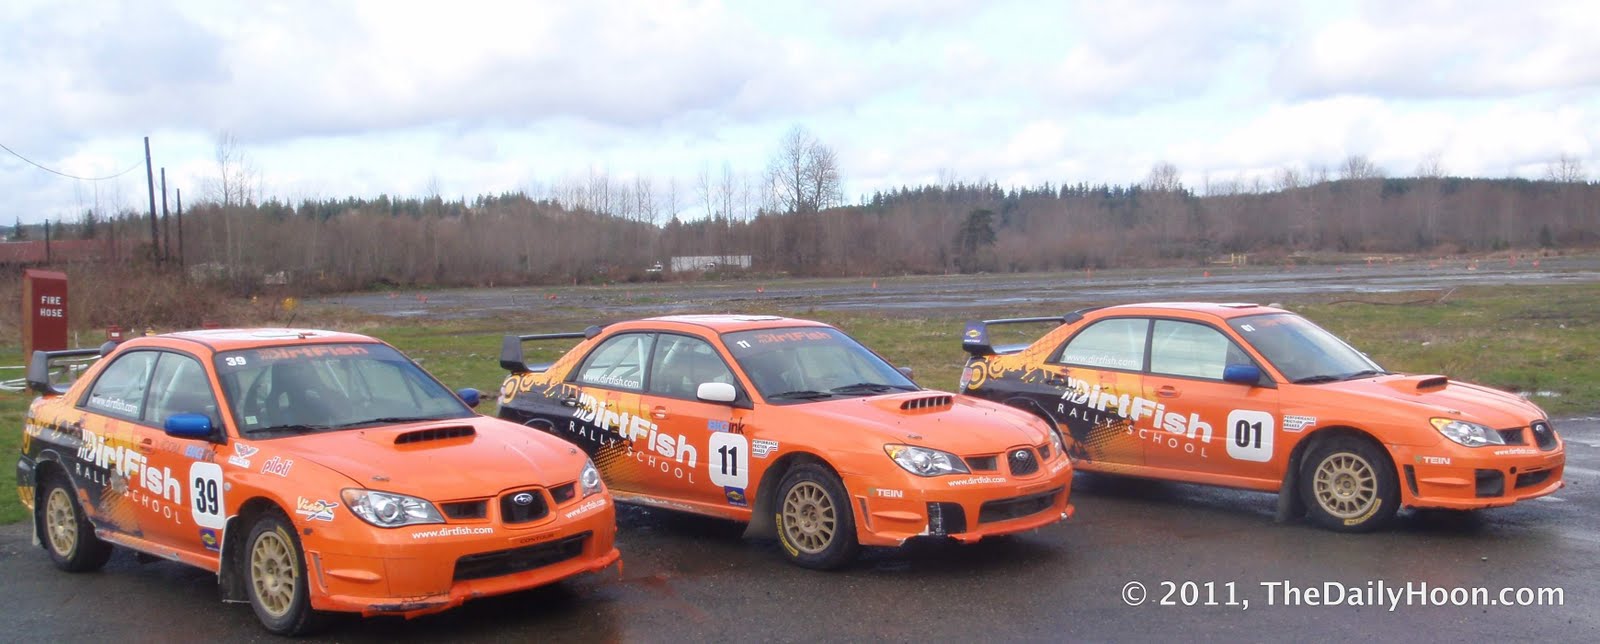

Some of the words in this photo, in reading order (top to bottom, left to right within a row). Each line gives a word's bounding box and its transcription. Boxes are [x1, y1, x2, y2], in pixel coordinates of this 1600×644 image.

[41, 295, 61, 305] FIRE
[40, 308, 63, 317] HOSE
[736, 340, 751, 349] 11
[225, 356, 247, 366] 39
[1066, 354, 1137, 367] www.dirtfish.com
[583, 374, 639, 388] www.dirtfish.com
[1061, 376, 1213, 443] DirtFish
[573, 392, 698, 469] DirtFish
[1057, 403, 1113, 428] RALLY
[1126, 424, 1208, 458] SCHOOL
[1235, 419, 1262, 450] 01
[569, 420, 616, 449] RALLY
[626, 446, 695, 484] SCHOOL
[1423, 456, 1450, 464] TEIN
[77, 428, 181, 505] DirtFish
[262, 457, 294, 476] piloti
[718, 445, 737, 476] 11
[948, 476, 1007, 487] www.dirtfish.com
[75, 462, 114, 490] RALL
[124, 485, 181, 524] SCHOOL
[195, 477, 219, 516] 39
[876, 488, 903, 498] TEIN
[412, 526, 494, 540] www.dirtfish.com
